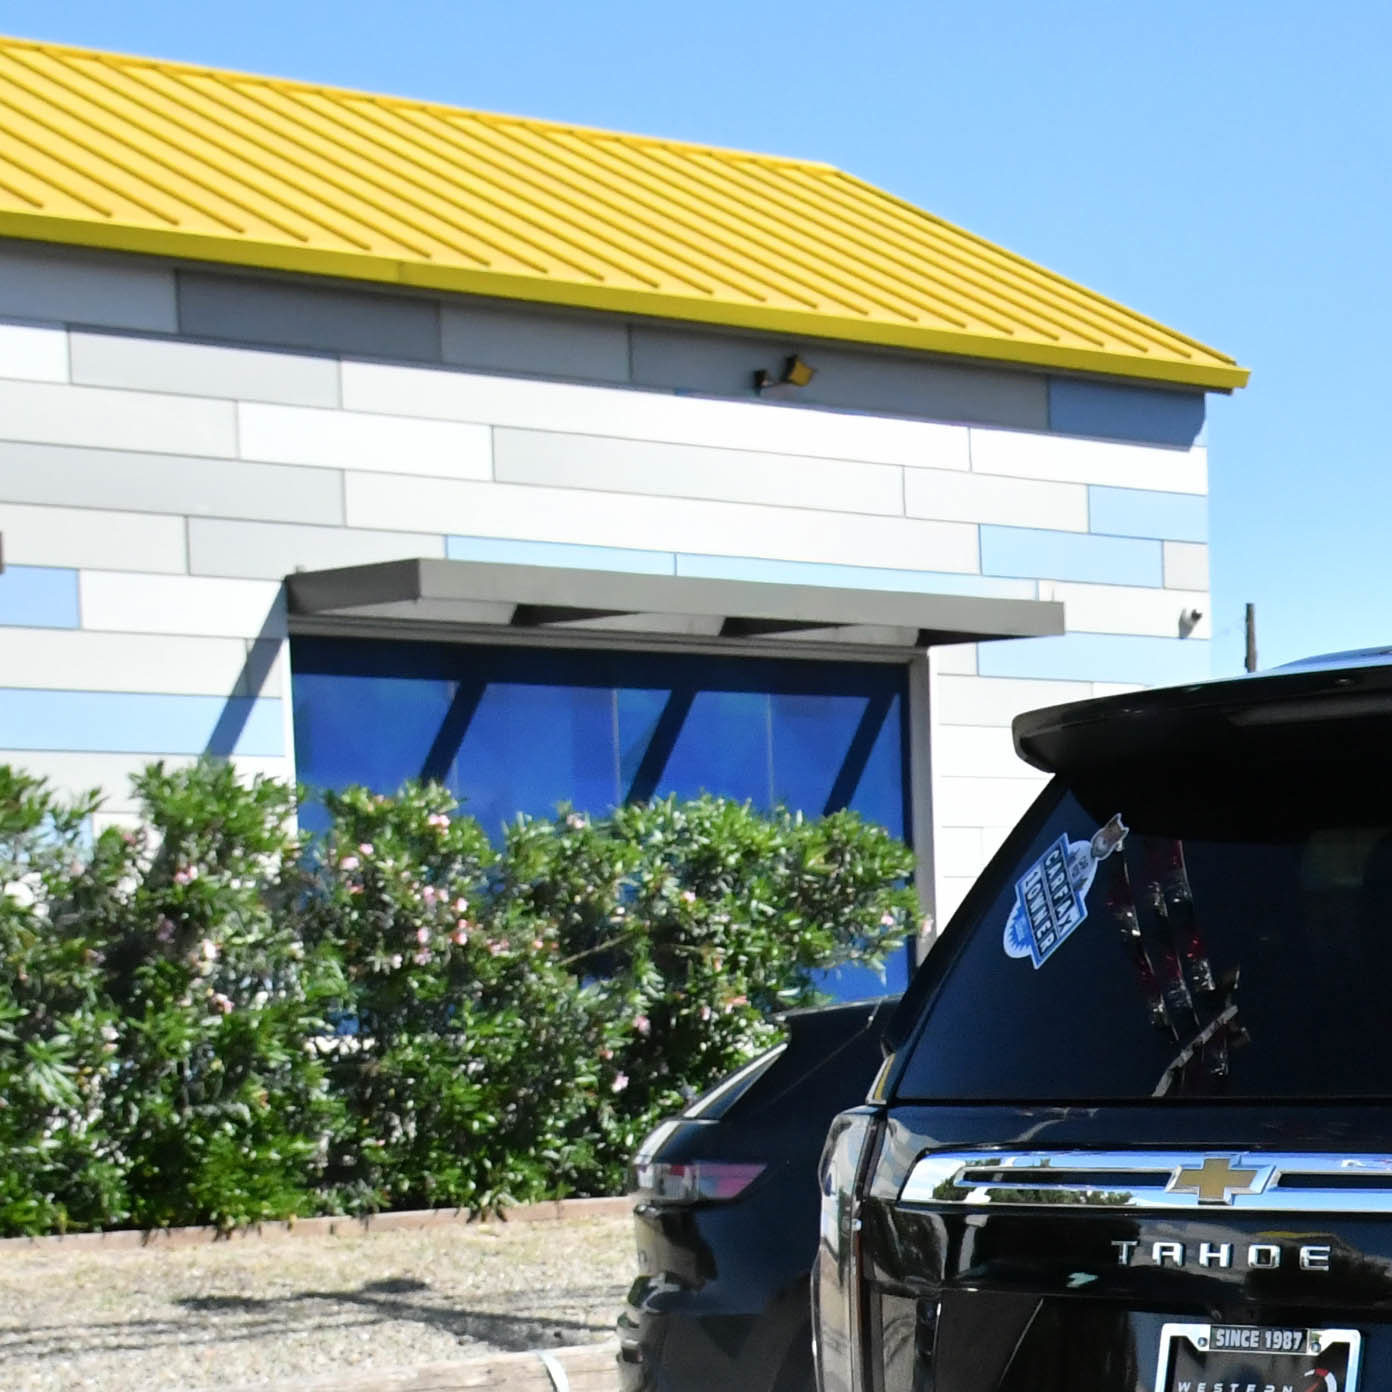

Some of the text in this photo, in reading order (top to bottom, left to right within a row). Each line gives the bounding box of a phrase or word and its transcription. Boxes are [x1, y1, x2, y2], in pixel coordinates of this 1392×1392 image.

[1045, 849, 1073, 935] CARFAX
[1111, 1240, 1331, 1271] TAHOE
[1216, 1328, 1303, 1350] SINCE 1987
